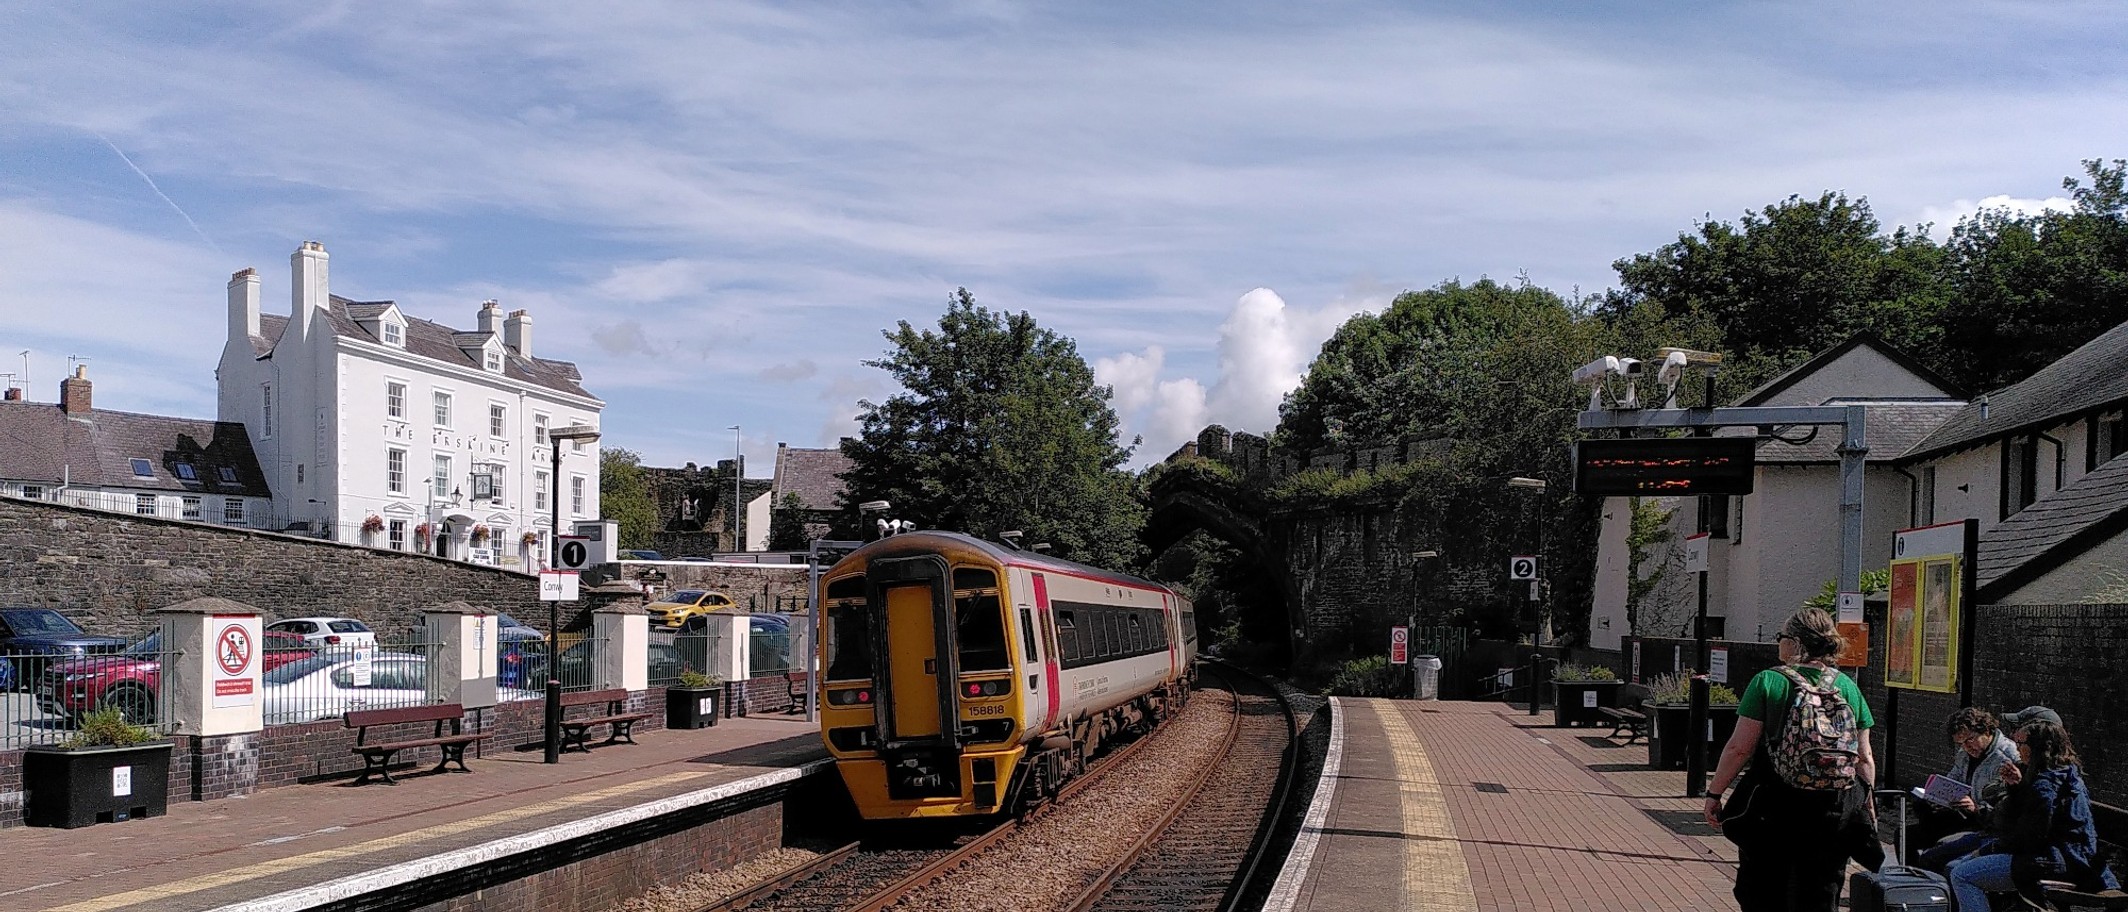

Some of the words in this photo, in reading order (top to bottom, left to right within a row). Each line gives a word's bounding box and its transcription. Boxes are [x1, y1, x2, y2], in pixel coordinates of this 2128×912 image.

[382, 425, 413, 440] THE
[432, 433, 507, 456] ERSKINE
[570, 545, 578, 563] 1
[1519, 561, 1528, 575] 2
[543, 581, 563, 594] Conwy
[968, 704, 1005, 716] 158818
[1002, 721, 1010, 732] 7
